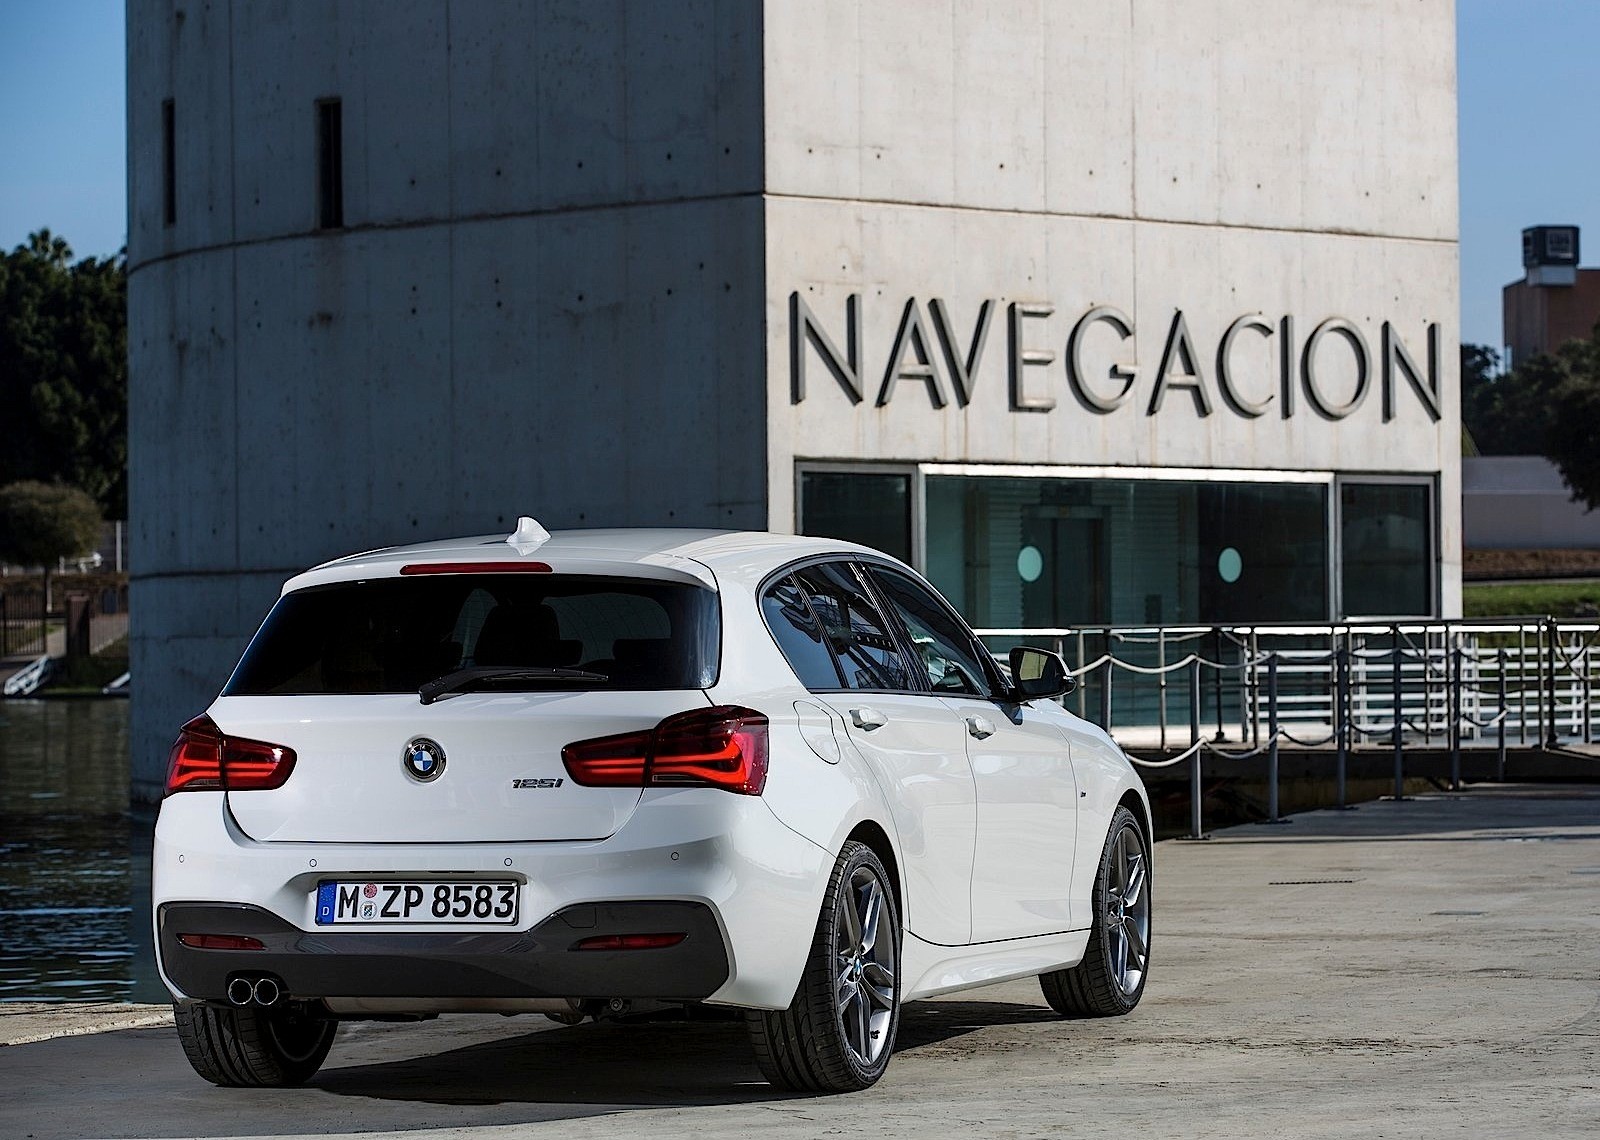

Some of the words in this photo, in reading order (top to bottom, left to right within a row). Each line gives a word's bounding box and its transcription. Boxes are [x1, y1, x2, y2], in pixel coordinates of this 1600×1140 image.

[789, 291, 1442, 424] NAVEGACION
[321, 906, 330, 916] D
[338, 886, 359, 918] M
[380, 886, 423, 918] ZP
[431, 885, 515, 918] 8583
